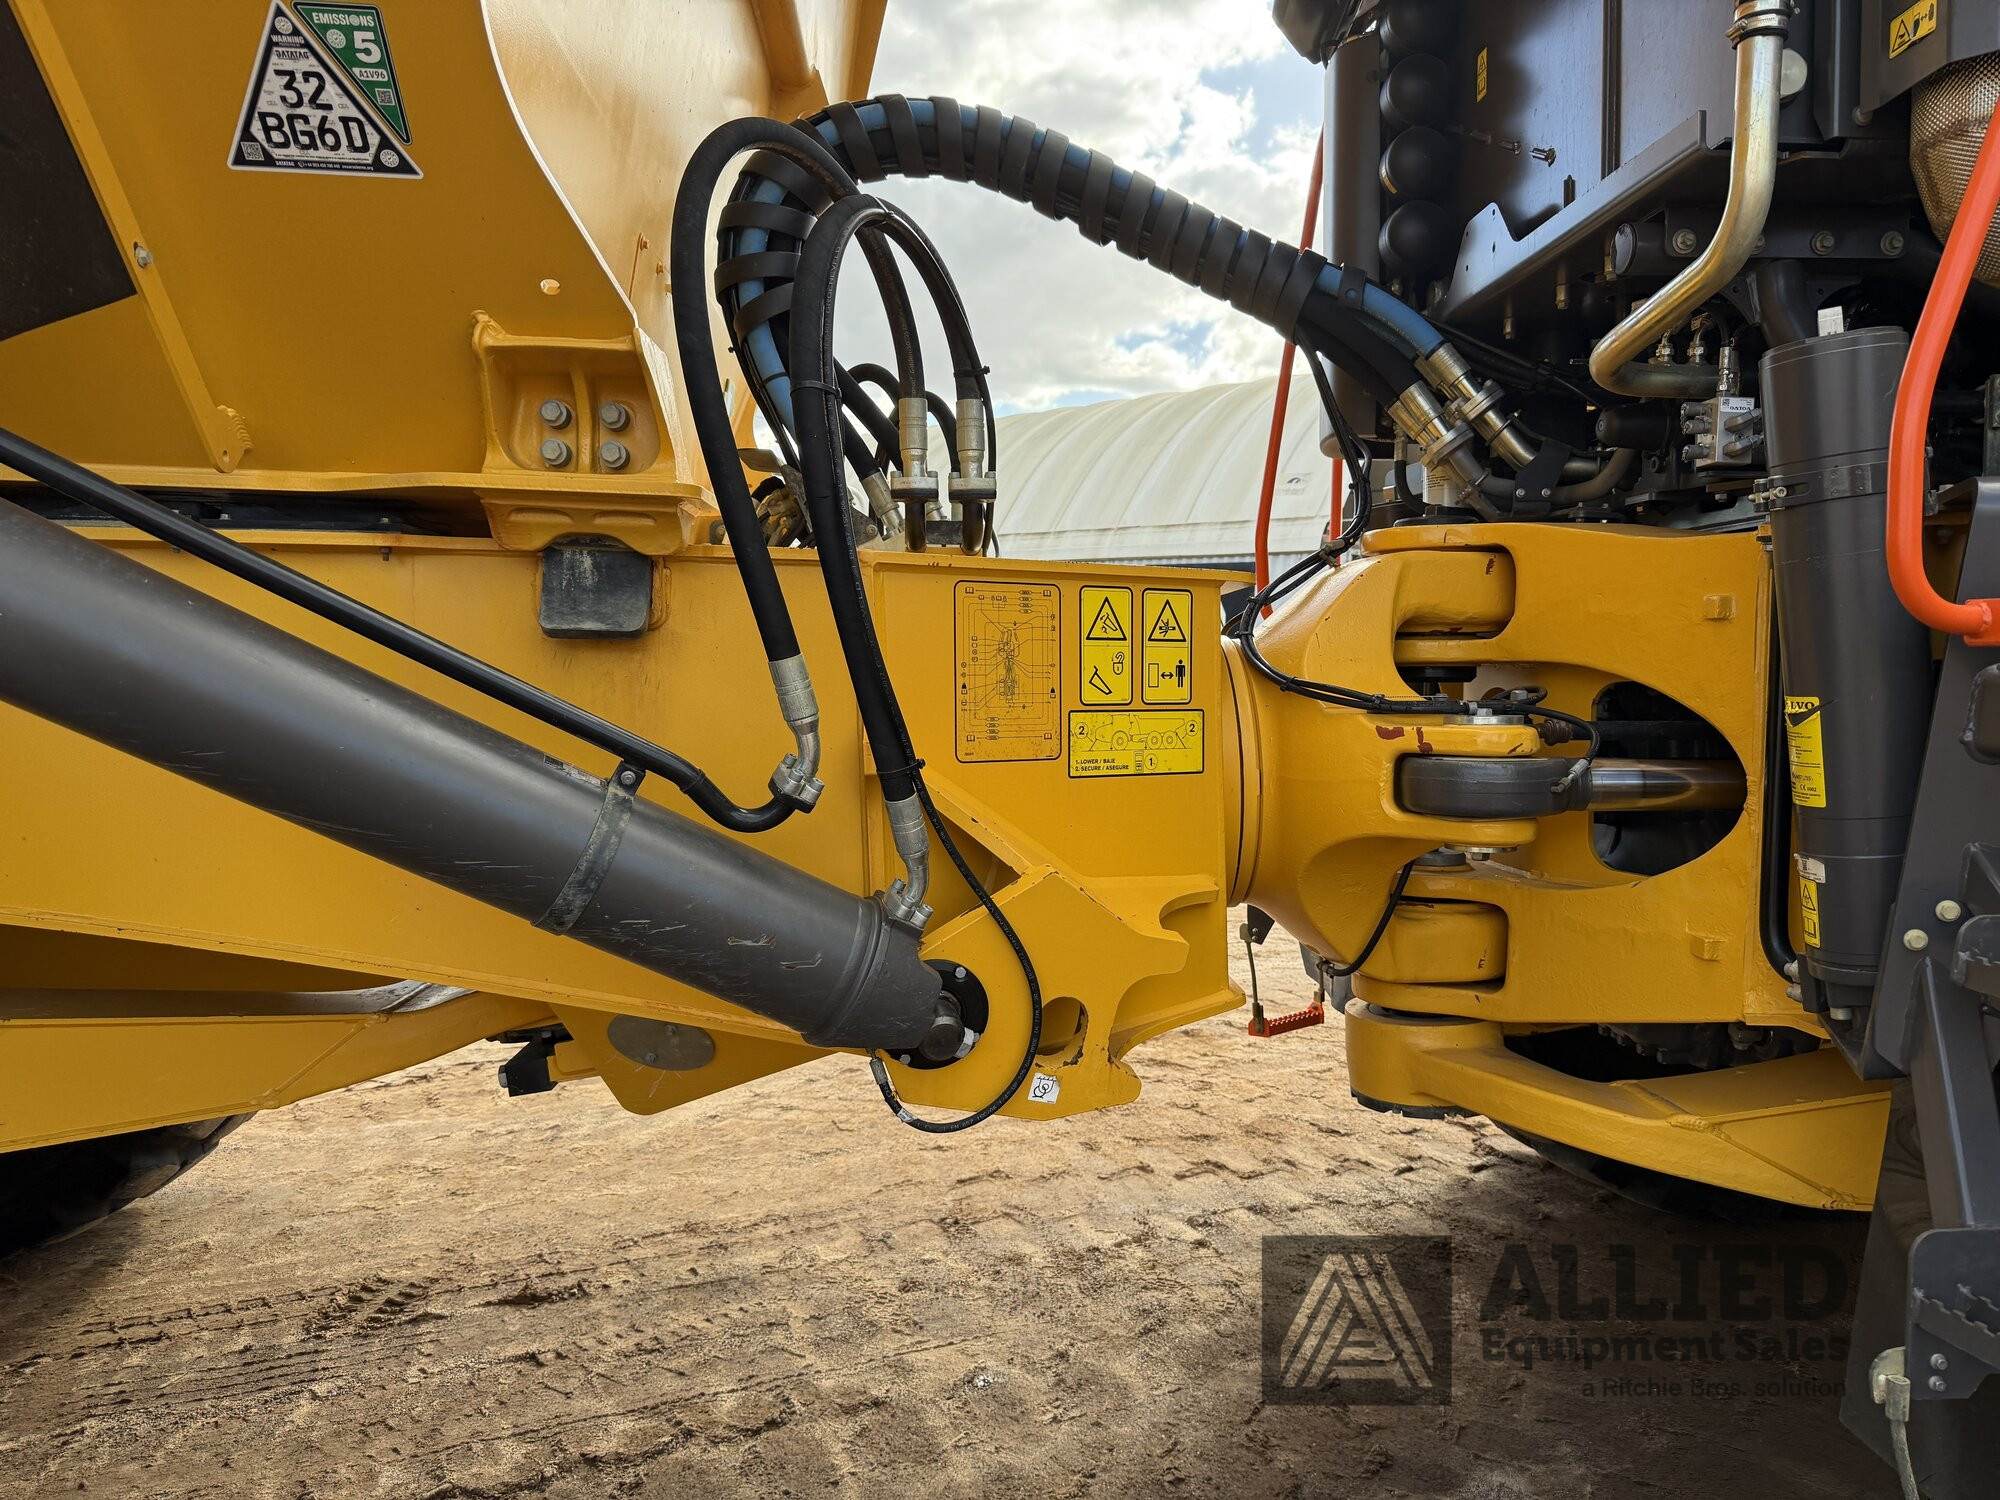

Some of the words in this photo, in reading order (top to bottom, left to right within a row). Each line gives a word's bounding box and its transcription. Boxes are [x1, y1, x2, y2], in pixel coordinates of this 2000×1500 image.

[271, 34, 305, 45] WARNING
[353, 30, 382, 64] 5
[275, 50, 309, 60] DATATAG
[358, 69, 386, 80] A1V96
[273, 69, 334, 111] 32
[257, 111, 371, 153] BG6D
[1078, 726, 1085, 735] 2
[1189, 723, 1195, 733] 2
